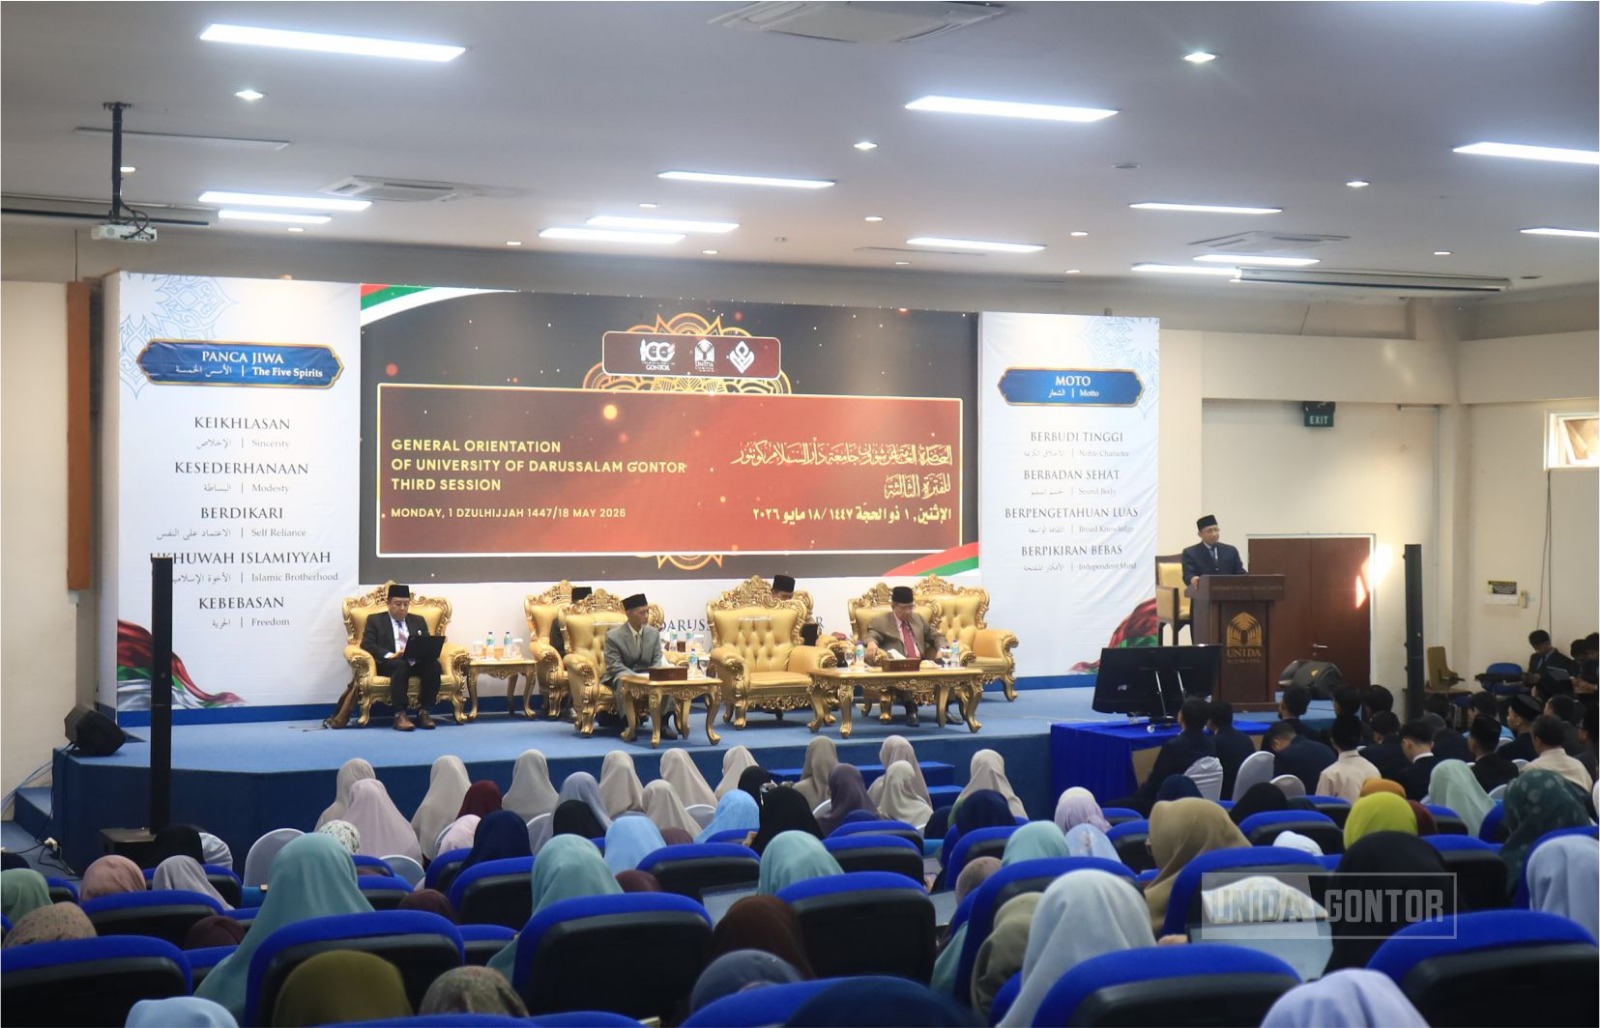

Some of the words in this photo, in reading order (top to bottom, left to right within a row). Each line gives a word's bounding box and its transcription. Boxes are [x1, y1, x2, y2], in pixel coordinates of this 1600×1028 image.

[202, 352, 248, 364] PANCA
[252, 352, 284, 364] JIWA
[252, 366, 270, 376] The
[272, 367, 292, 378] Five
[293, 367, 324, 380] Spirits
[1056, 376, 1092, 386] MOTO
[1079, 390, 1100, 398] Motto
[194, 417, 290, 430] KEIKHLASAN
[1309, 415, 1328, 424] EXIT
[1030, 432, 1079, 442] BERBUDI
[1083, 432, 1124, 442] TINGGI
[252, 438, 290, 450] Sincerity
[391, 439, 460, 452] GENERAL
[464, 440, 561, 453] ORIENTATION
[175, 462, 309, 474] KESEDERHANAAN
[391, 458, 412, 471] OF
[416, 459, 500, 472] UNIVERSITY
[505, 460, 524, 472] OF
[529, 460, 622, 473] DARUSSALAM
[627, 461, 687, 474] GONTOR
[1024, 470, 1082, 480] BERBADAN
[1086, 470, 1120, 480] SEHAT
[252, 483, 290, 494] Modesty
[391, 478, 436, 490] THIRD
[440, 479, 501, 492] SESSION
[201, 507, 284, 519] BERDIKARI
[391, 508, 445, 520] MONDAY,
[448, 508, 452, 518] 1
[456, 508, 524, 518] DZULHIJJAH
[527, 508, 570, 520] 1447/18
[572, 508, 596, 518] MAY
[600, 508, 626, 518] 2026
[752, 508, 780, 520] ٢٠٢٦
[782, 508, 806, 525] مايو
[1005, 508, 1109, 518] BERPENGETAHUAN
[1112, 508, 1138, 518] LUAS
[252, 528, 268, 538] Self
[270, 528, 306, 538] Reliance
[1022, 546, 1088, 556] BERPIKIRAN
[1091, 545, 1123, 556] BEBAS
[240, 552, 331, 564] ISLAMIYYAH
[252, 572, 282, 582] Islamic
[285, 572, 338, 582] Brotherhood
[199, 597, 285, 610] KEBEBASAN
[252, 618, 290, 627] Freedom
[1226, 648, 1262, 658] UNIDA
